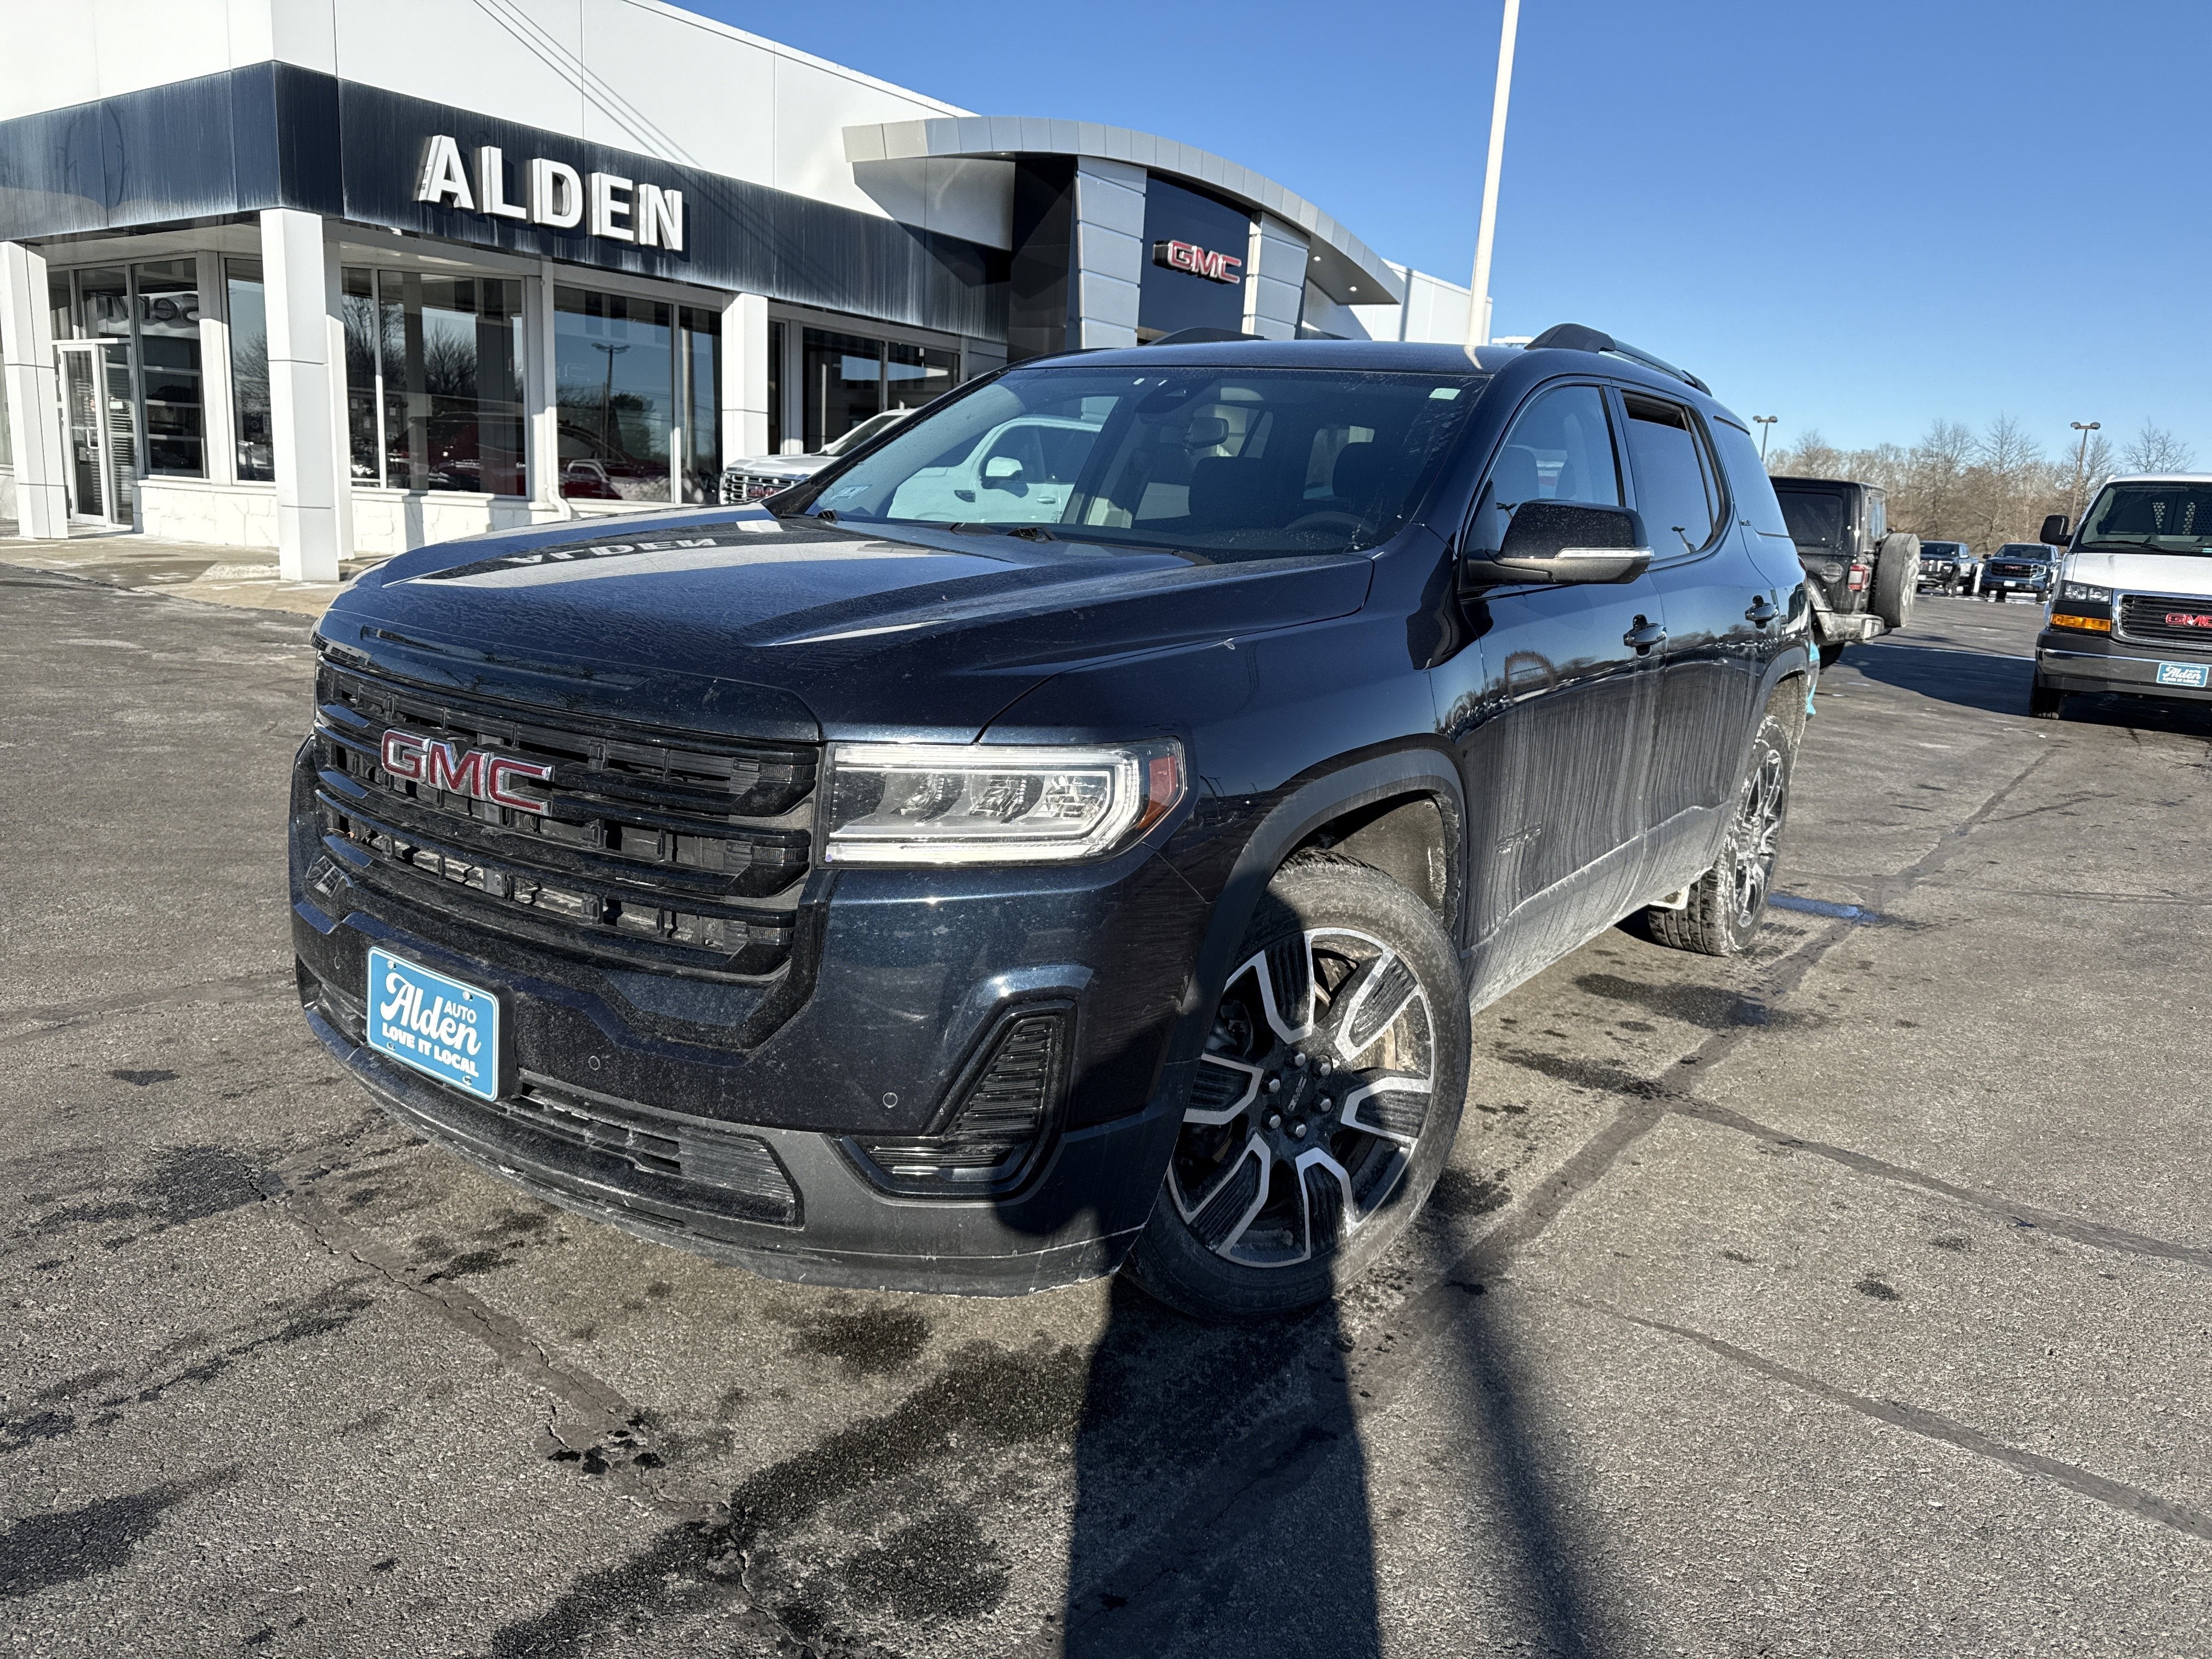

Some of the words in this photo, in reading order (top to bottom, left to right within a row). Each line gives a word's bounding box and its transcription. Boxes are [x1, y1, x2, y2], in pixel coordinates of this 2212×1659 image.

[419, 134, 683, 252] ALDEN
[1167, 240, 1242, 284] GMC
[2163, 667, 2202, 680] Alden
[381, 728, 555, 817] GMC
[380, 972, 481, 1055] Alden
[444, 1000, 477, 1024] AUTO
[382, 1022, 416, 1048] LOVE
[418, 1037, 431, 1056] IT
[434, 1046, 479, 1077] LOCAL
[1288, 1076, 1307, 1111] GMC
